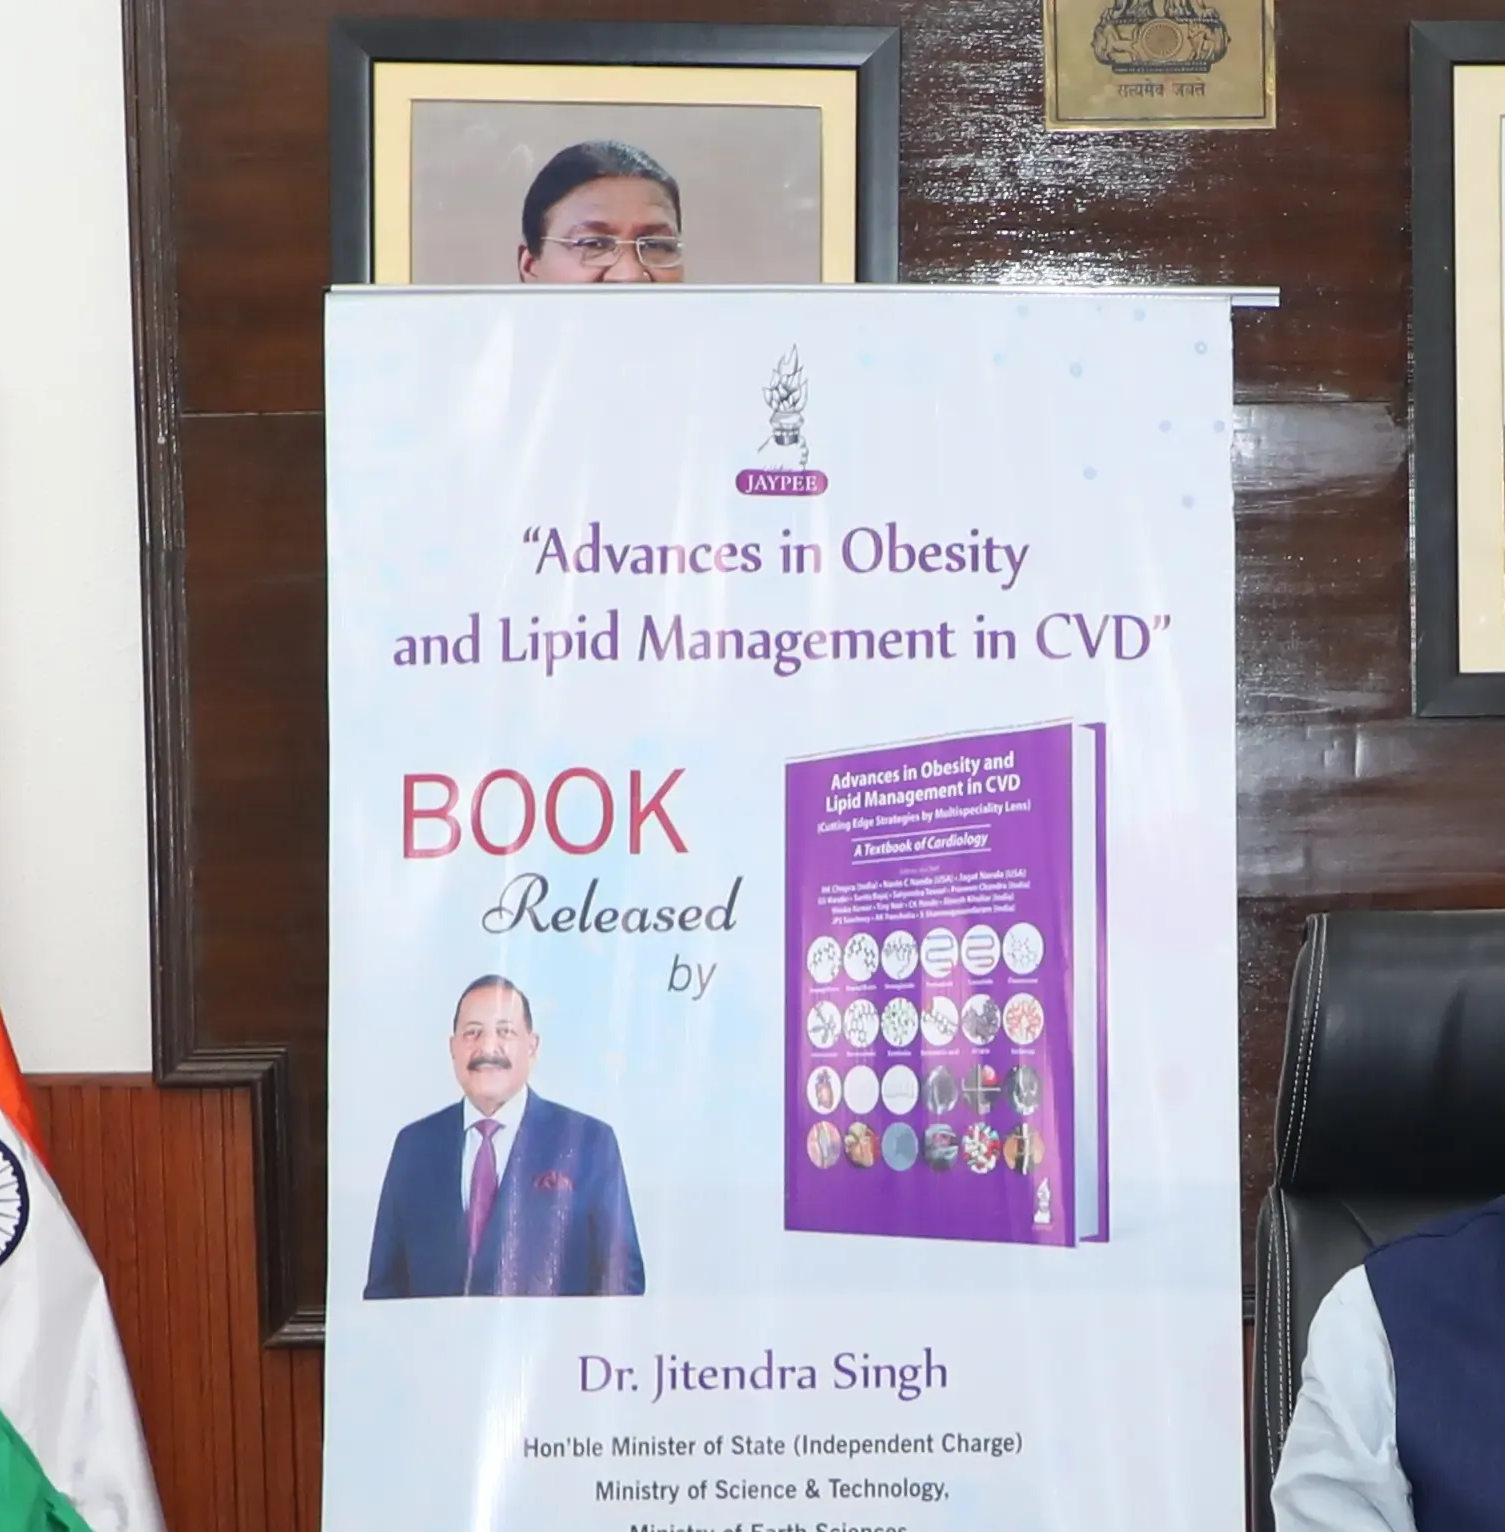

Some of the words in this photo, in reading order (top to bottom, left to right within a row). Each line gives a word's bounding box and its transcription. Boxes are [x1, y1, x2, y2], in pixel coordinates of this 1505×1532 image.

[745, 474, 817, 493] JAYPEE
[524, 522, 762, 574] “Advances
[780, 529, 820, 573] in
[842, 522, 1029, 590] Obesity
[394, 613, 479, 666] and
[500, 609, 618, 677] Lipid
[638, 615, 956, 677] Management
[974, 615, 1015, 659] in
[1036, 613, 1170, 660] CVD”
[831, 769, 899, 791] Advances
[903, 765, 917, 781] in
[921, 757, 981, 778] Obesity
[984, 751, 1014, 770] and
[401, 766, 690, 860] BOOK
[826, 791, 861, 815] Lipid
[865, 781, 963, 808] Management
[967, 778, 982, 795] in
[986, 774, 1021, 793] CVD
[854, 845, 862, 857] A
[865, 841, 913, 856] Textbook
[914, 837, 926, 851] of
[927, 832, 988, 850] Cardiology
[481, 871, 743, 936] Released
[666, 954, 717, 1000] by
[579, 1356, 638, 1391] Dr.
[652, 1349, 816, 1403] Jitendra
[834, 1347, 946, 1401] Singh
[524, 1437, 603, 1457] Hon'ble
[612, 1437, 695, 1456] Minister
[704, 1436, 723, 1455] of
[732, 1435, 785, 1455] State
[794, 1434, 933, 1458] (Independent
[942, 1433, 1022, 1457] Charge)
[596, 1481, 679, 1504] Ministry
[688, 1480, 707, 1500] of
[716, 1479, 797, 1499] Science
[805, 1479, 820, 1499] &
[829, 1478, 948, 1502] Technology,
